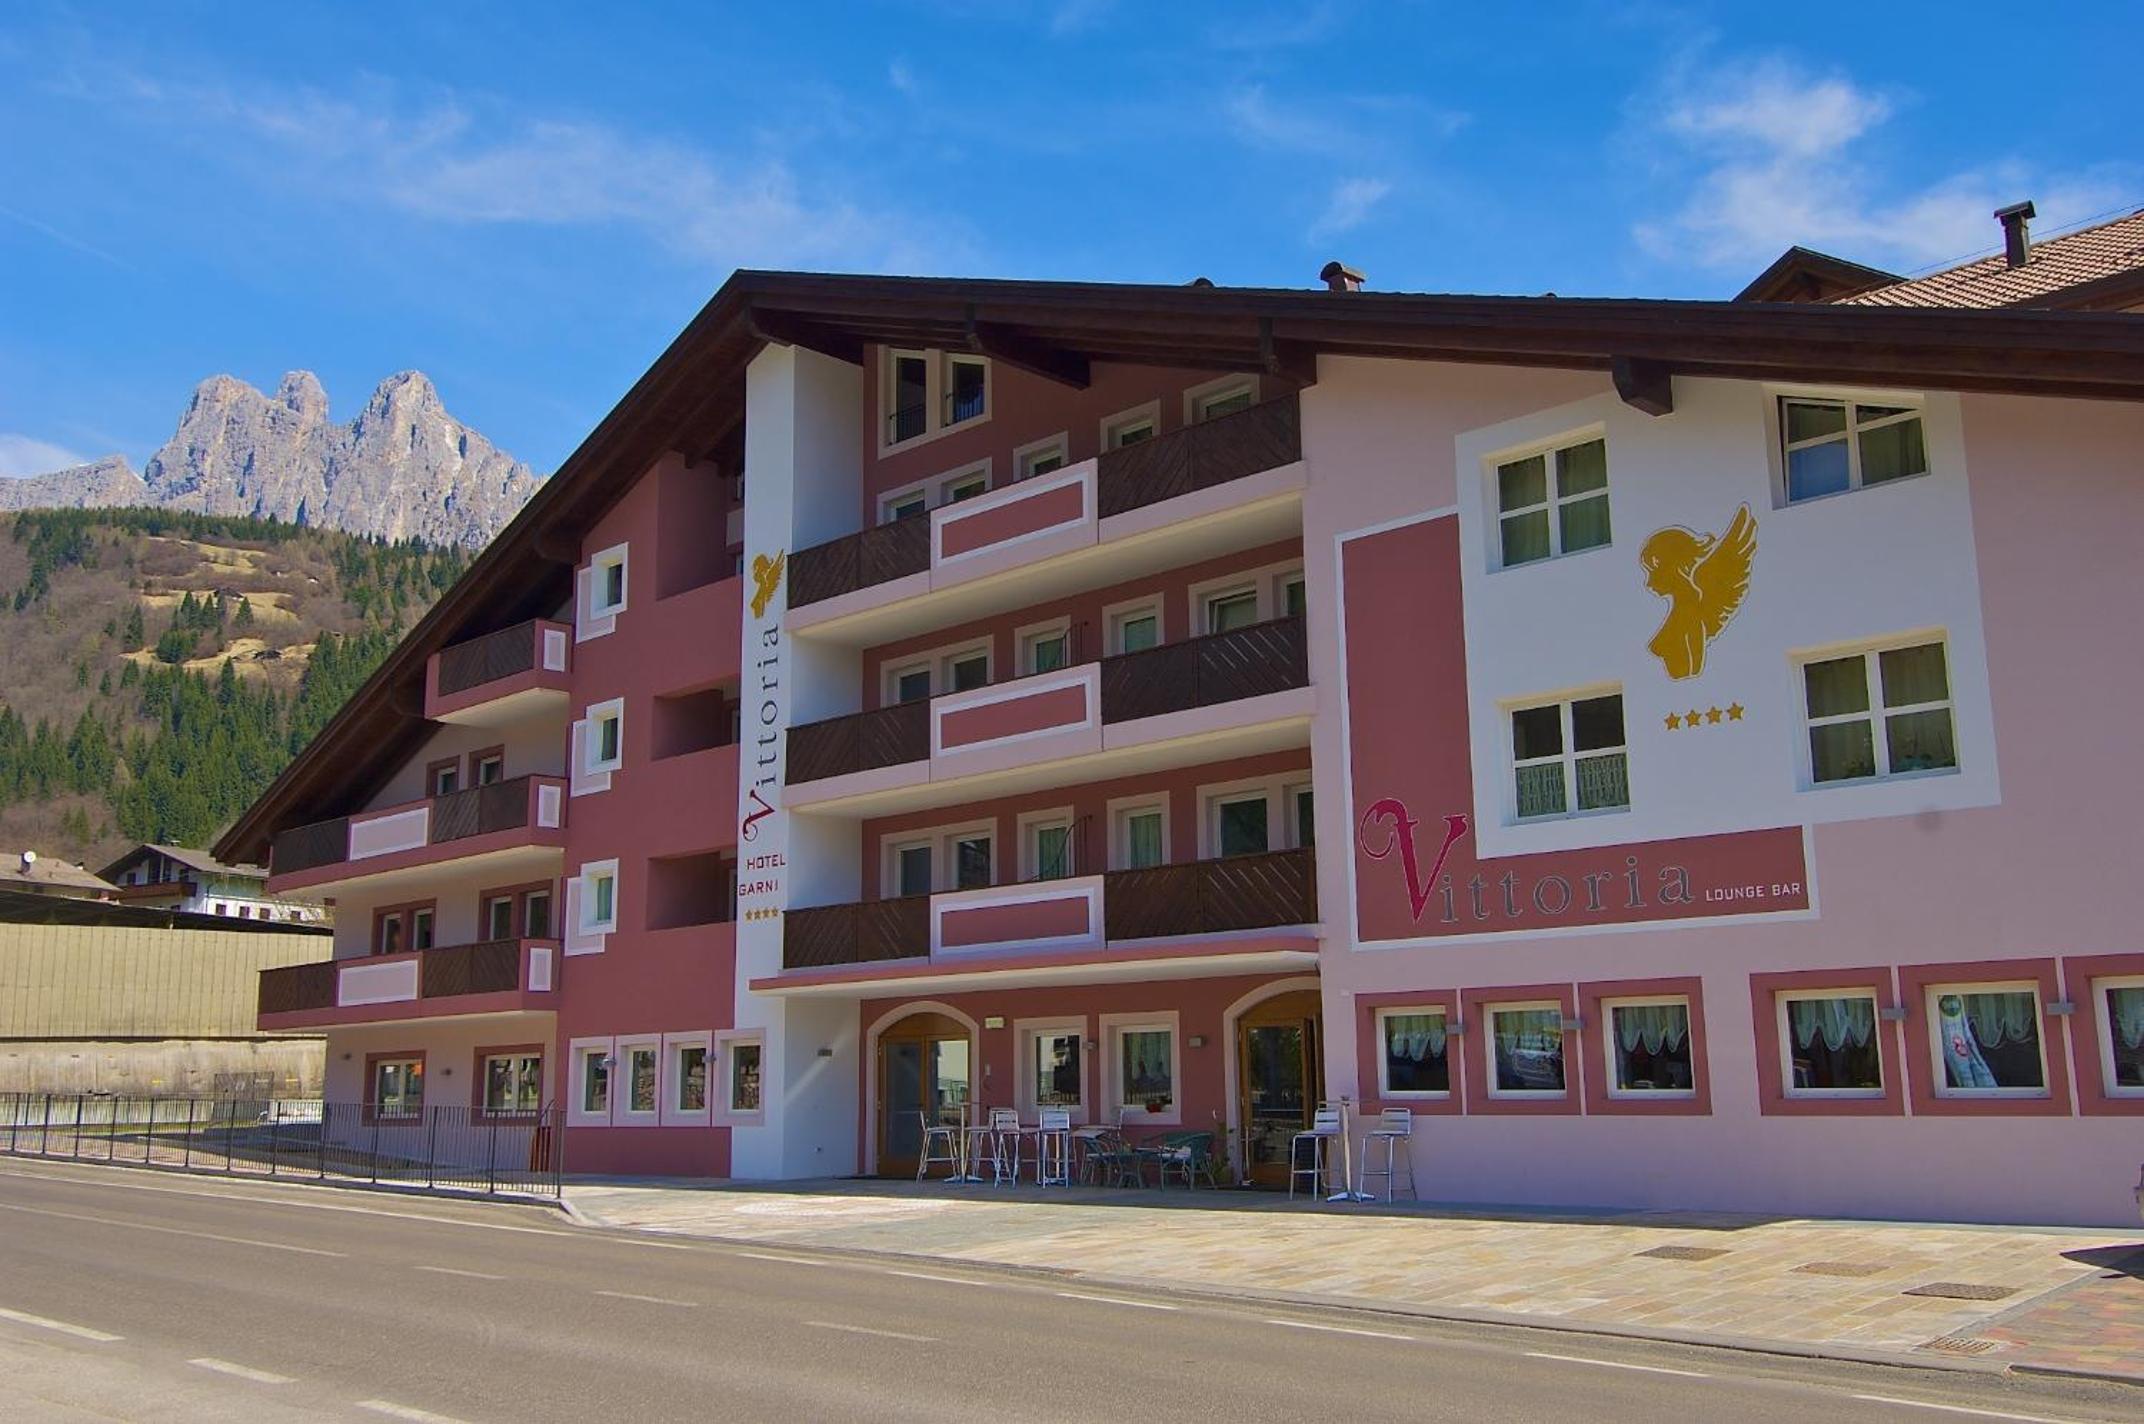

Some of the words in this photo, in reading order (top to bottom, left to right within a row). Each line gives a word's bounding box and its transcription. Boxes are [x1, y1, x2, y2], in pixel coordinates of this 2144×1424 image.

[742, 623, 780, 842] Vittoria
[738, 880, 779, 897] GARNI
[746, 854, 786, 870] HOTEL
[1360, 798, 1694, 925] Vittoria
[1705, 884, 1765, 902] LOUNGE
[1772, 882, 1801, 897] BAR
